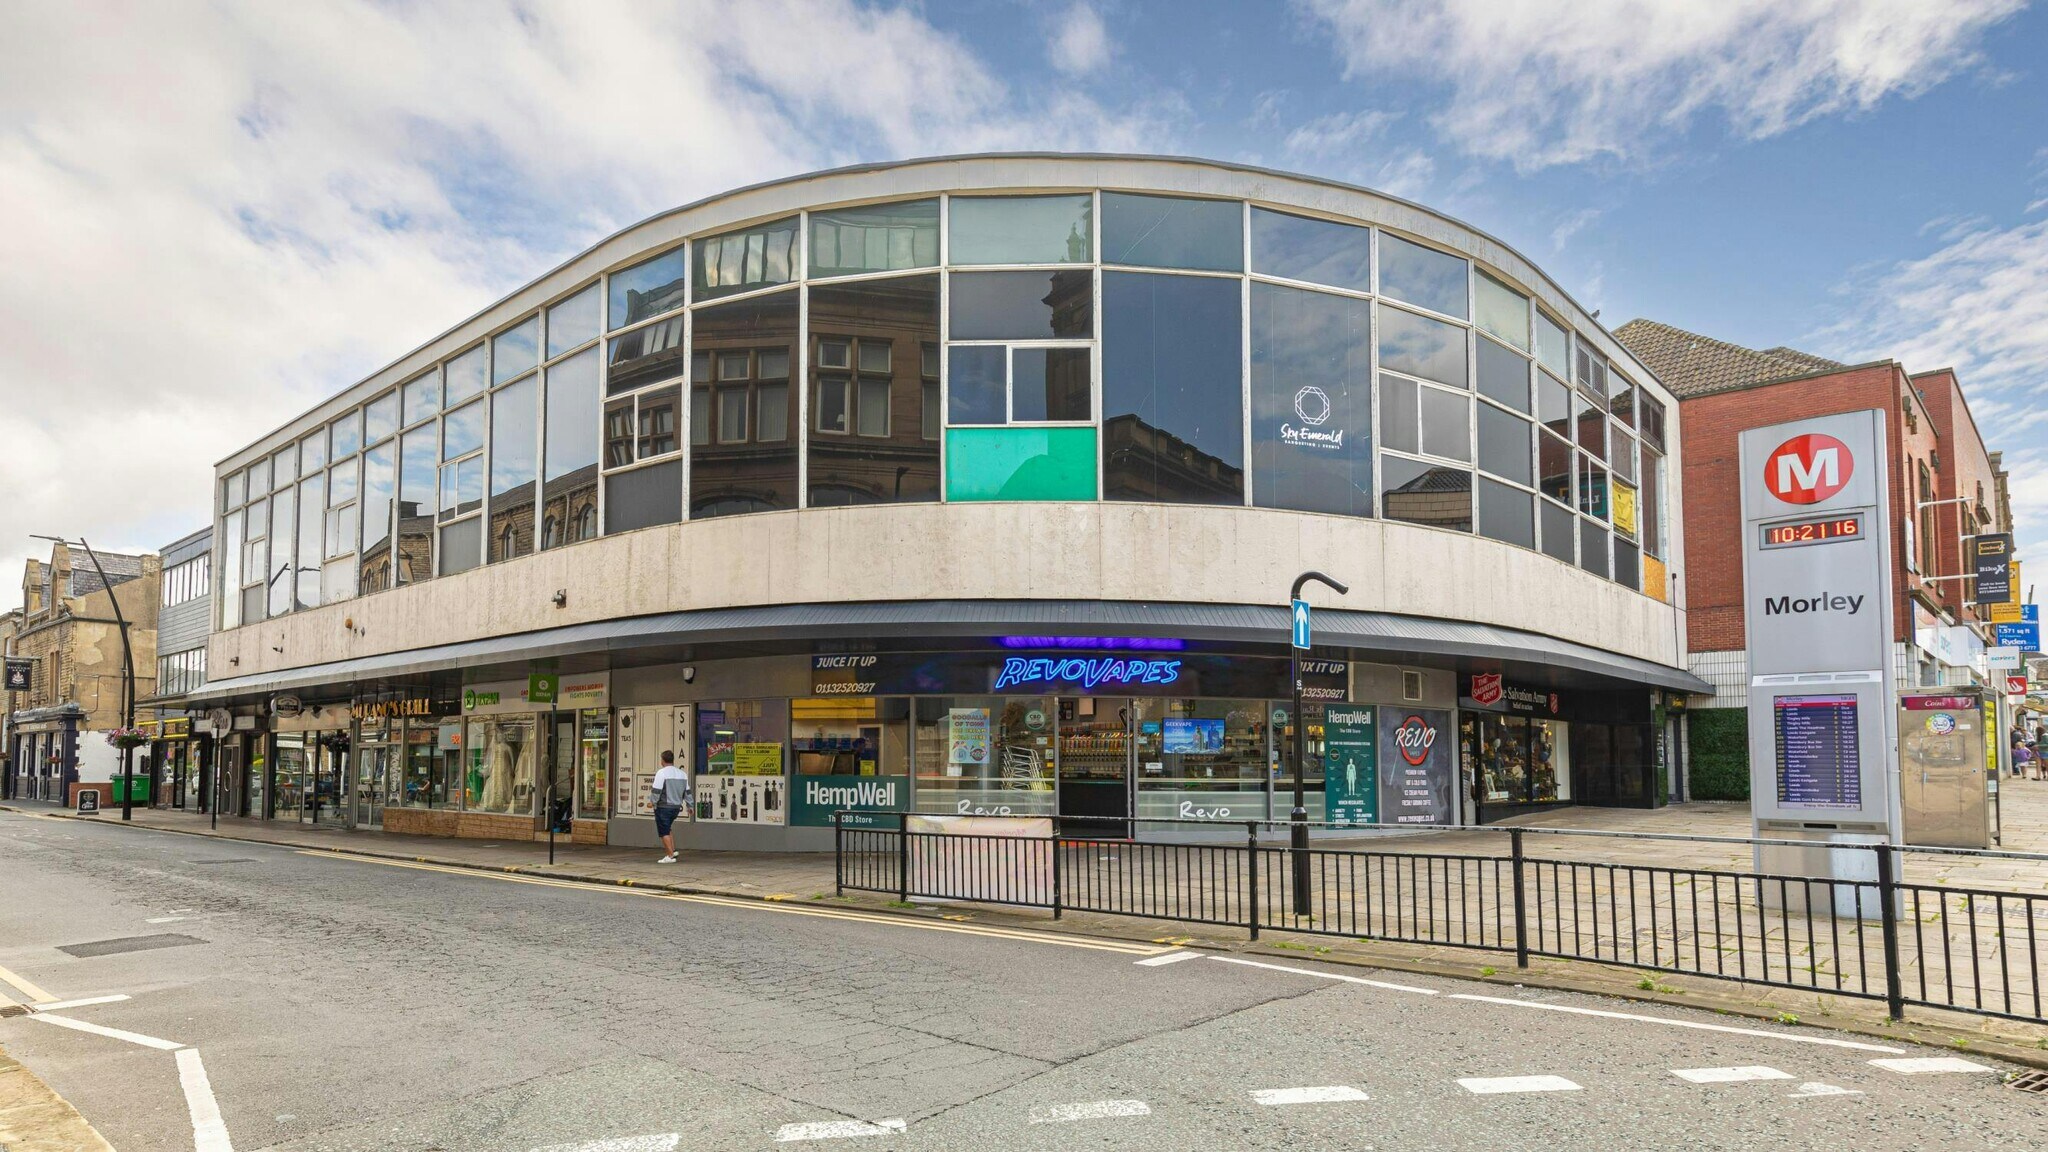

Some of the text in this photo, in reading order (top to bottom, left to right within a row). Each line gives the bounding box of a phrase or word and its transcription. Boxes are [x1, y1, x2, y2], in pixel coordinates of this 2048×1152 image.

[1281, 423, 1343, 446] Sky Emerald
[1777, 448, 1839, 493] M
[1765, 592, 1864, 616] Morley
[2002, 638, 2027, 646] Ryden
[817, 656, 877, 668] JUICE IT UP
[1301, 661, 1345, 674] IX IT UP
[996, 657, 1181, 688] REVOVAPES
[816, 683, 875, 693] 01132520927
[1301, 688, 1345, 699] 132520927
[1473, 680, 1498, 696] SALVATION
[1482, 688, 1497, 701] ARMY
[1507, 687, 1532, 702] Salvation
[1533, 691, 1547, 707] Army
[1925, 700, 1945, 708] Coins
[351, 698, 432, 719] MURANO'S GRILL
[1328, 710, 1371, 726] HempWell
[1395, 727, 1437, 748] REVO
[806, 781, 895, 809] HempWell
[958, 799, 1011, 815] Revo
[1179, 801, 1230, 819] Revo
[841, 815, 853, 823] CBD
[855, 815, 873, 823] Store
